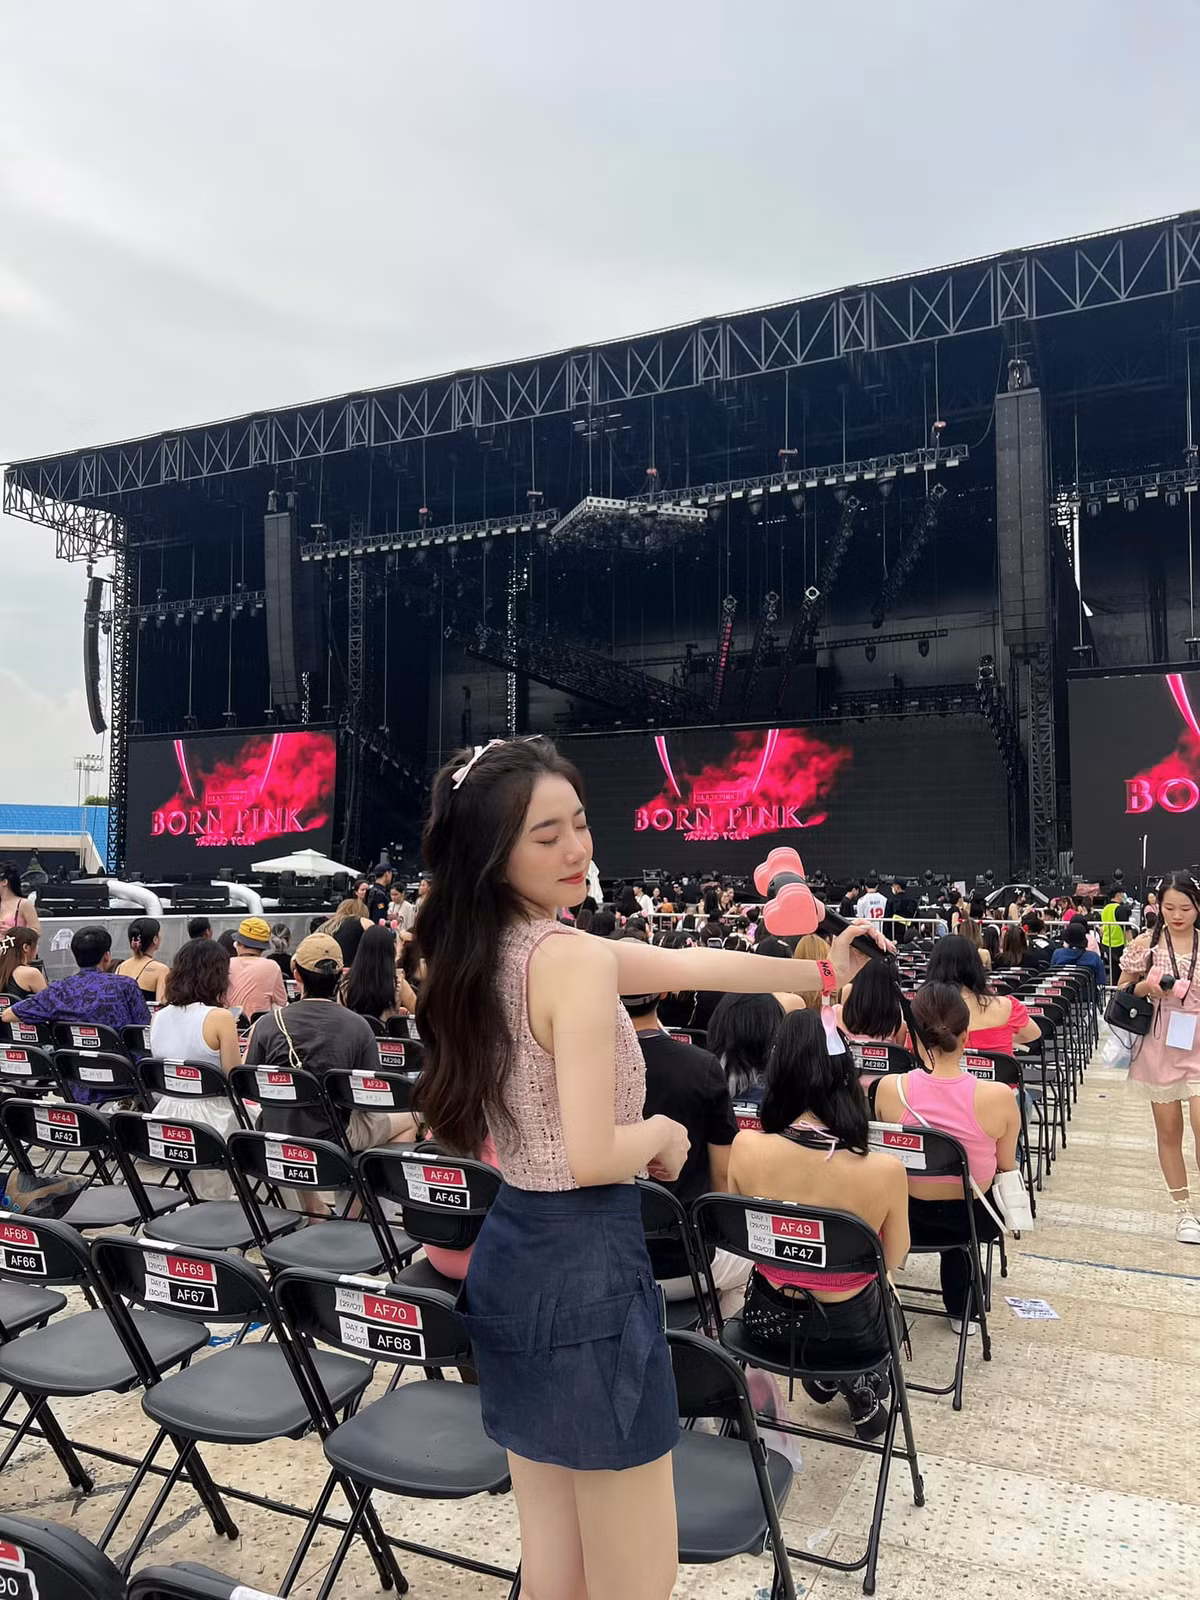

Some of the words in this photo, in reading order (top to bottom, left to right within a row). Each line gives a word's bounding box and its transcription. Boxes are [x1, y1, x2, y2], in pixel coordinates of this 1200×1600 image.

[1124, 778, 1200, 814] BO
[150, 809, 225, 835] BORN
[235, 807, 305, 833] PINK
[633, 808, 715, 831] BORN
[727, 805, 808, 829] PINK
[870, 908, 883, 918] 12
[864, 1048, 885, 1056] AE282
[179, 1068, 195, 1077] AF21
[271, 1074, 287, 1083] AF22
[367, 1080, 383, 1088] AF23
[52, 1113, 71, 1122] AF44
[55, 1131, 73, 1141] AF42
[167, 1129, 187, 1139] AF45
[890, 1137, 914, 1146] AF27
[168, 1149, 189, 1159] AF43
[288, 1149, 308, 1159] AF46
[288, 1168, 309, 1179] AF44
[430, 1170, 455, 1182] AF47
[435, 1192, 461, 1204] AF45
[4, 1227, 28, 1240] AF68
[780, 1222, 812, 1235] AF49
[753, 1235, 766, 1243] DAY
[783, 1245, 814, 1260] AF47
[11, 1255, 37, 1268] AF66
[175, 1262, 204, 1276] AF69
[151, 1278, 162, 1287] DAY
[177, 1288, 205, 1303] AF67
[341, 1290, 355, 1299] DAY
[339, 1299, 363, 1313] (29/07)
[374, 1302, 407, 1320] AF70
[345, 1322, 358, 1331] DAY
[344, 1332, 368, 1346] (30/07)
[377, 1334, 411, 1351] AF68
